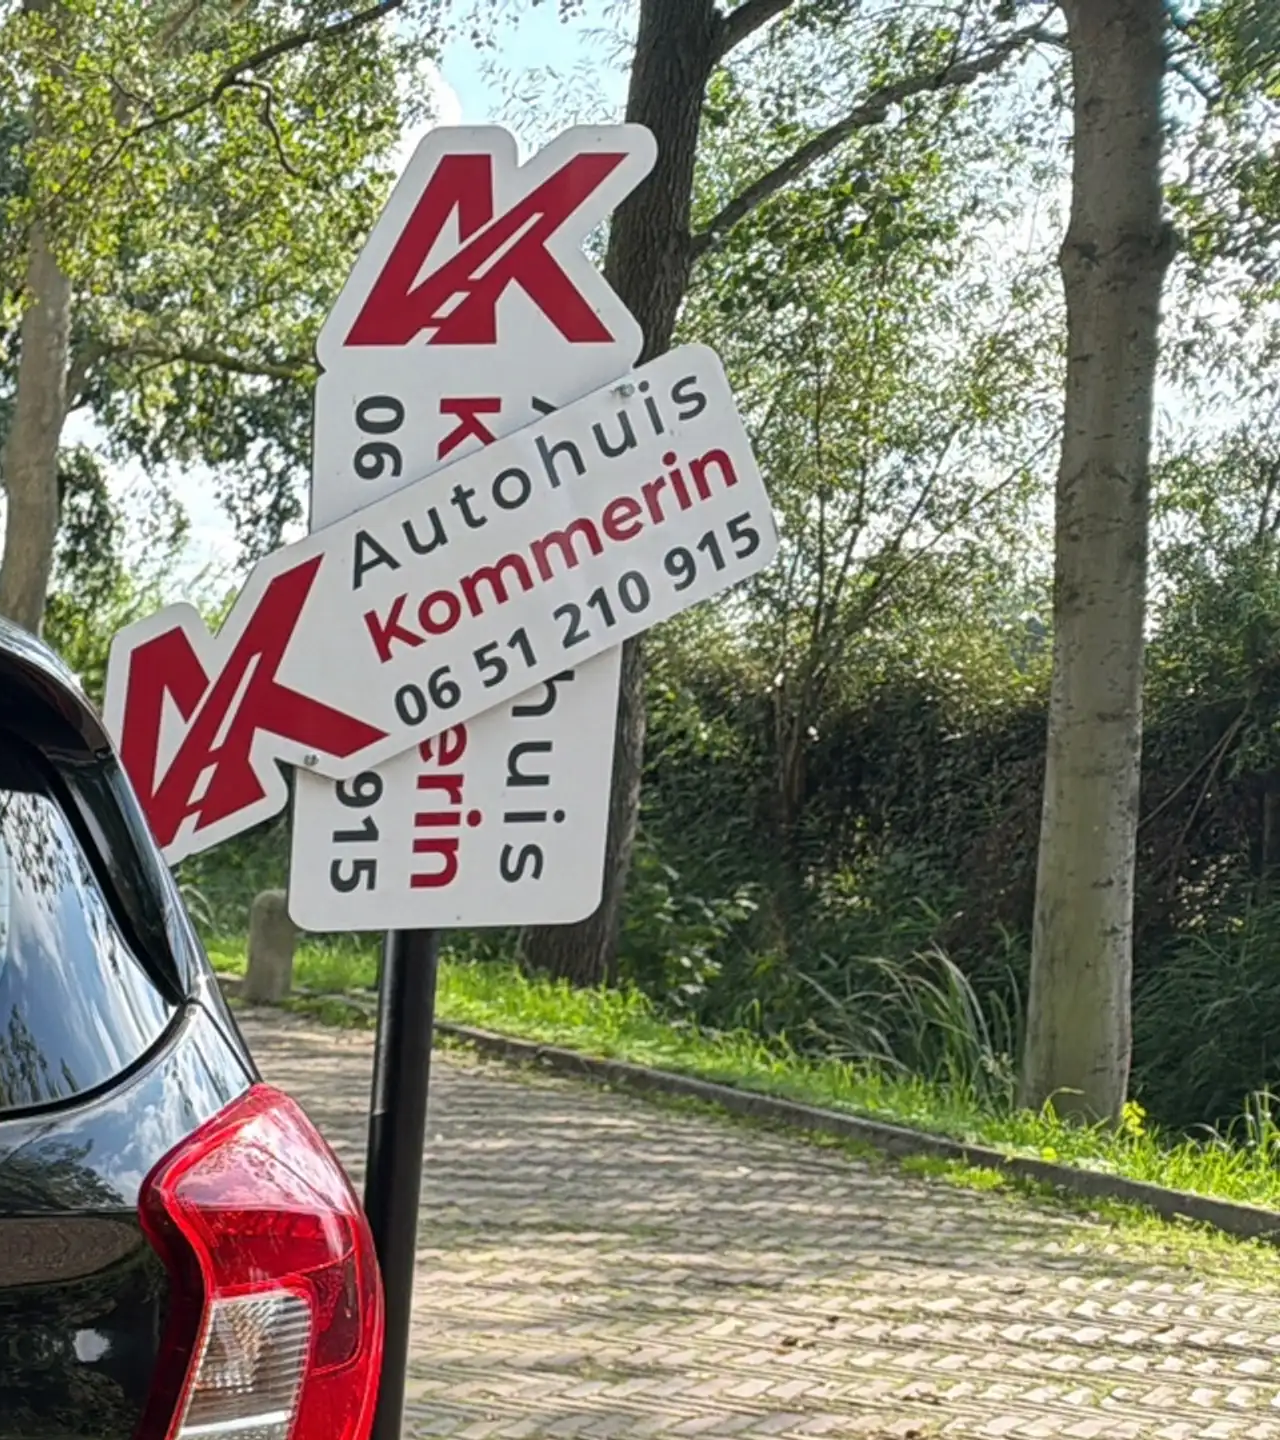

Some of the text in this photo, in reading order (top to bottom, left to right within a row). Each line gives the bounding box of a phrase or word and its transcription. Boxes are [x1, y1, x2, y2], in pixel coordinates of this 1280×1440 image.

[352, 375, 707, 591] Autohuis
[354, 395, 405, 480] 06
[363, 448, 739, 664] Kommerin
[394, 511, 761, 727] 06 51 210 915
[330, 770, 383, 893] 915
